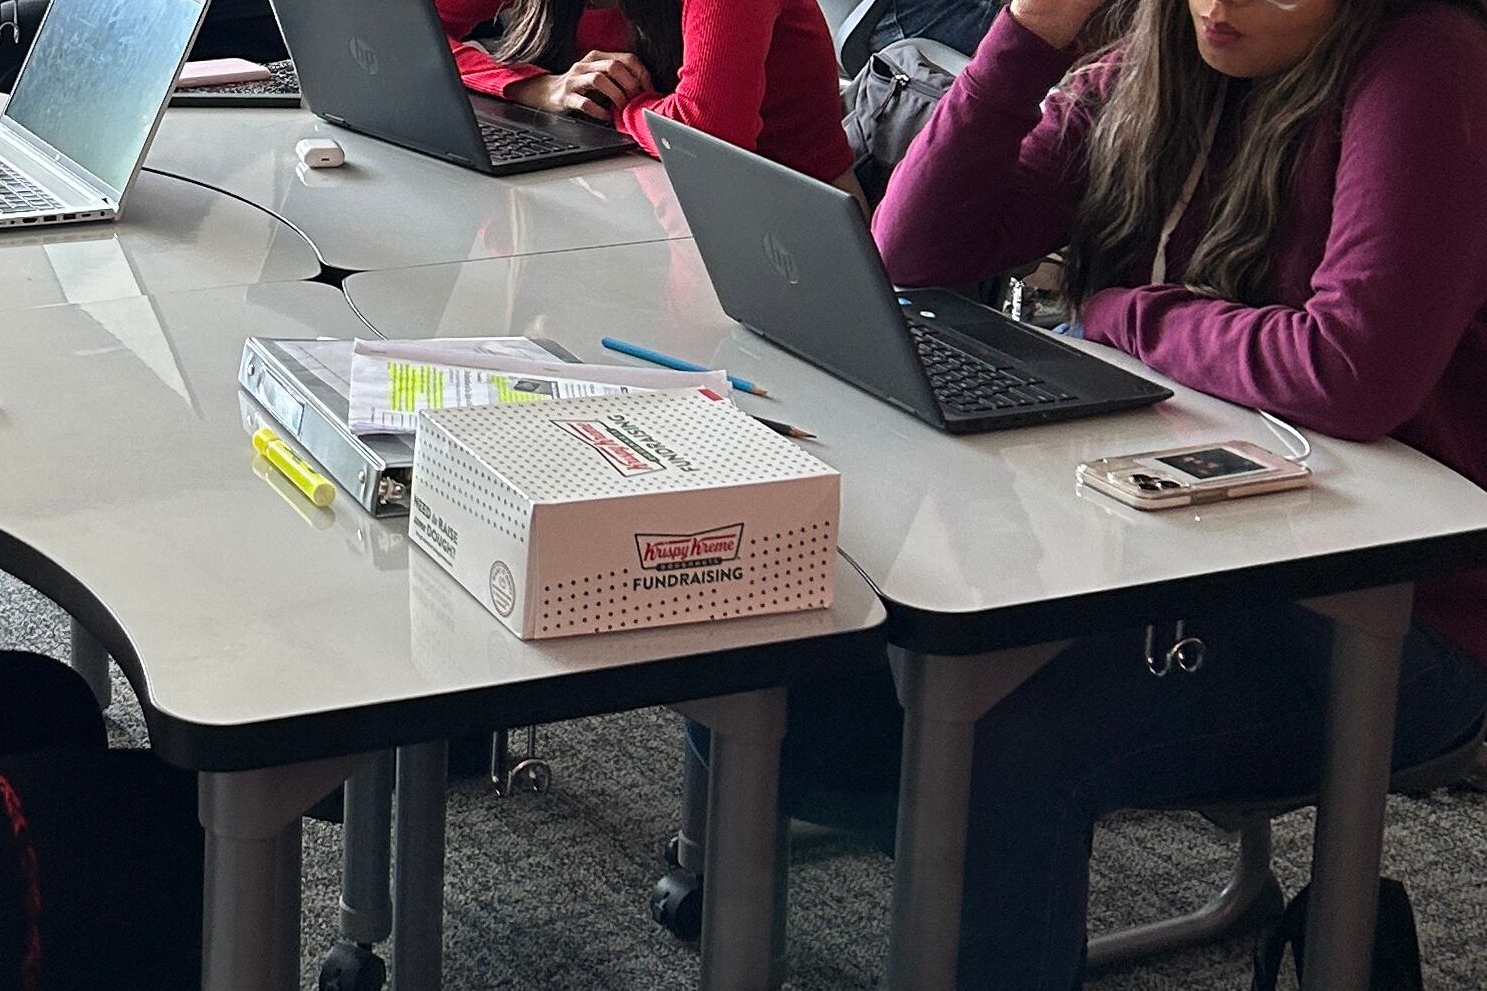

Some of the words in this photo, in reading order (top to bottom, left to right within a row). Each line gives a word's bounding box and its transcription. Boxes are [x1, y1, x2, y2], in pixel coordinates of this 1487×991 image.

[606, 414, 700, 472] FUNDRAISING
[427, 524, 456, 559] DOUGH?
[439, 517, 458, 545] RAISE
[644, 539, 691, 563] Krispy
[690, 534, 737, 557] Kreme
[633, 567, 743, 591] FUNDRAISING
